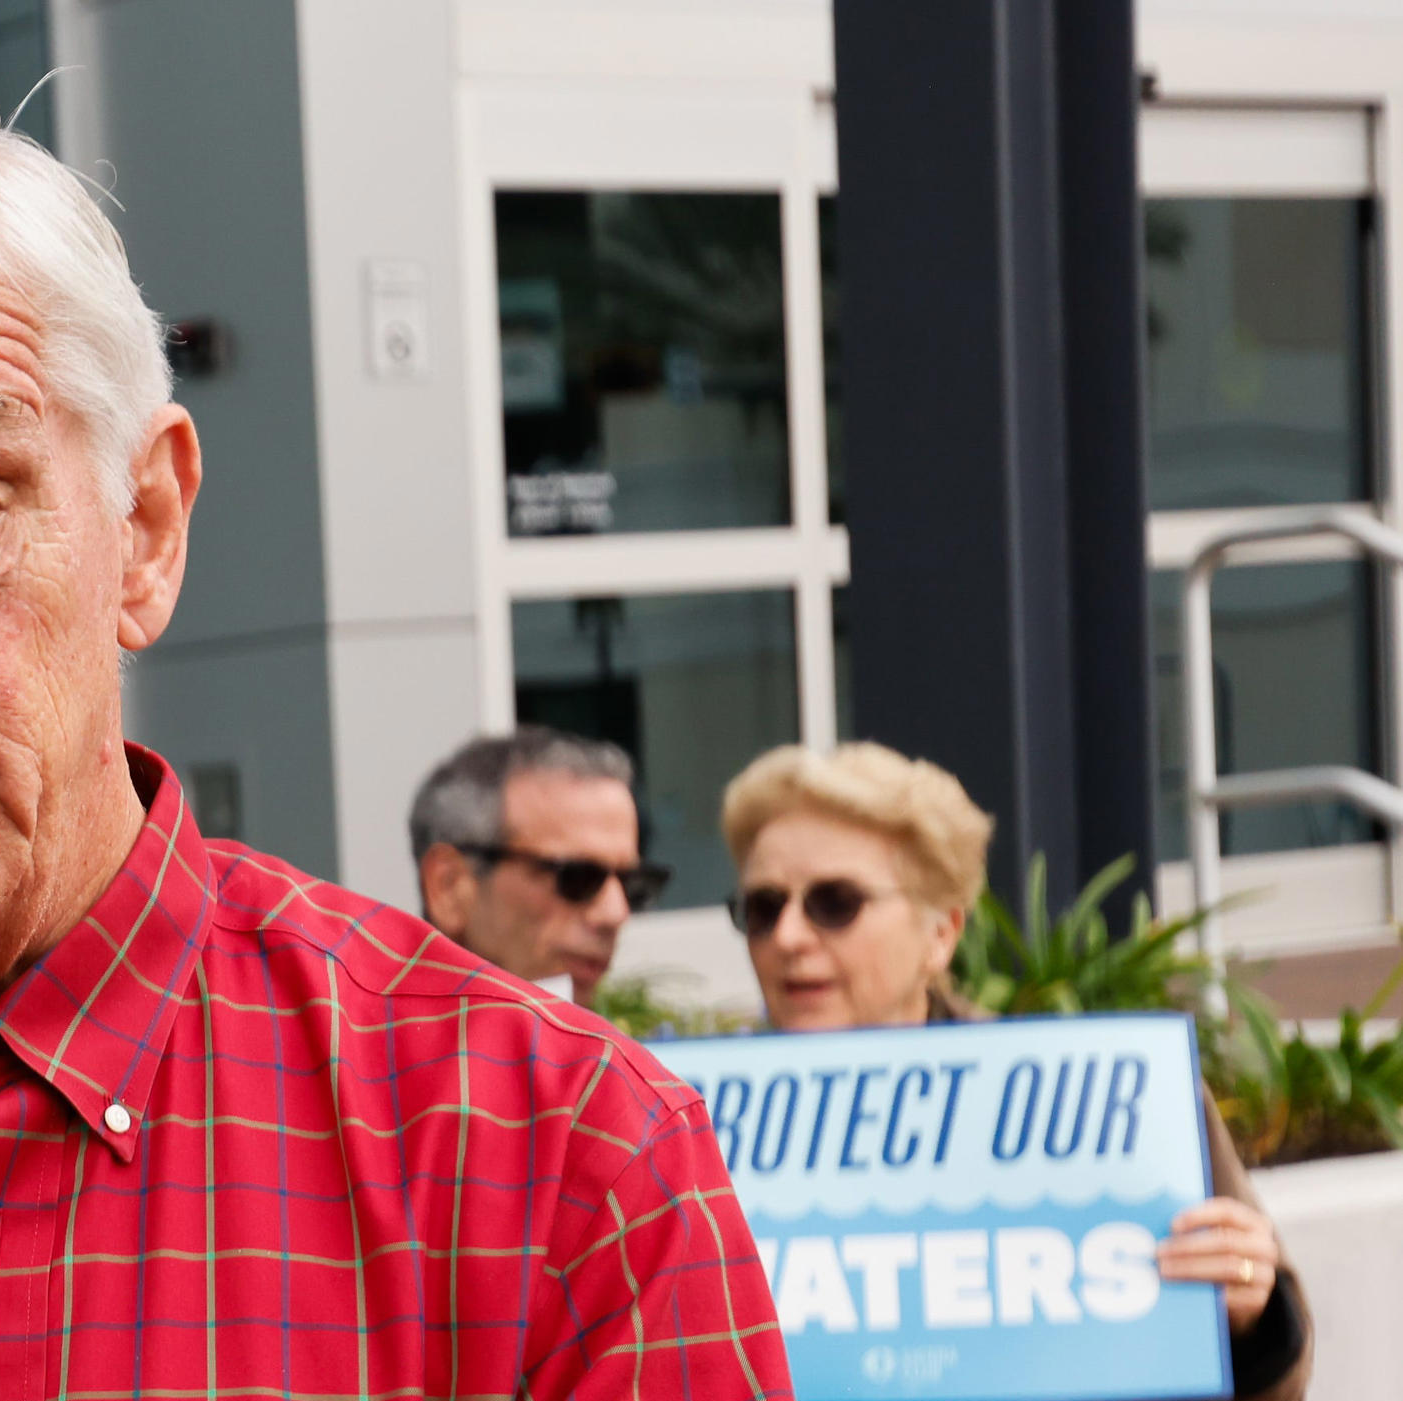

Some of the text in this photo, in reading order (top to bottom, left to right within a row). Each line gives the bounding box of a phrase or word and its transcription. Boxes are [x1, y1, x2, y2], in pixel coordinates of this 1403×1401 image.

[693, 1055, 1148, 1174] ROTECT OUR
[757, 1222, 1161, 1335] ATERS
